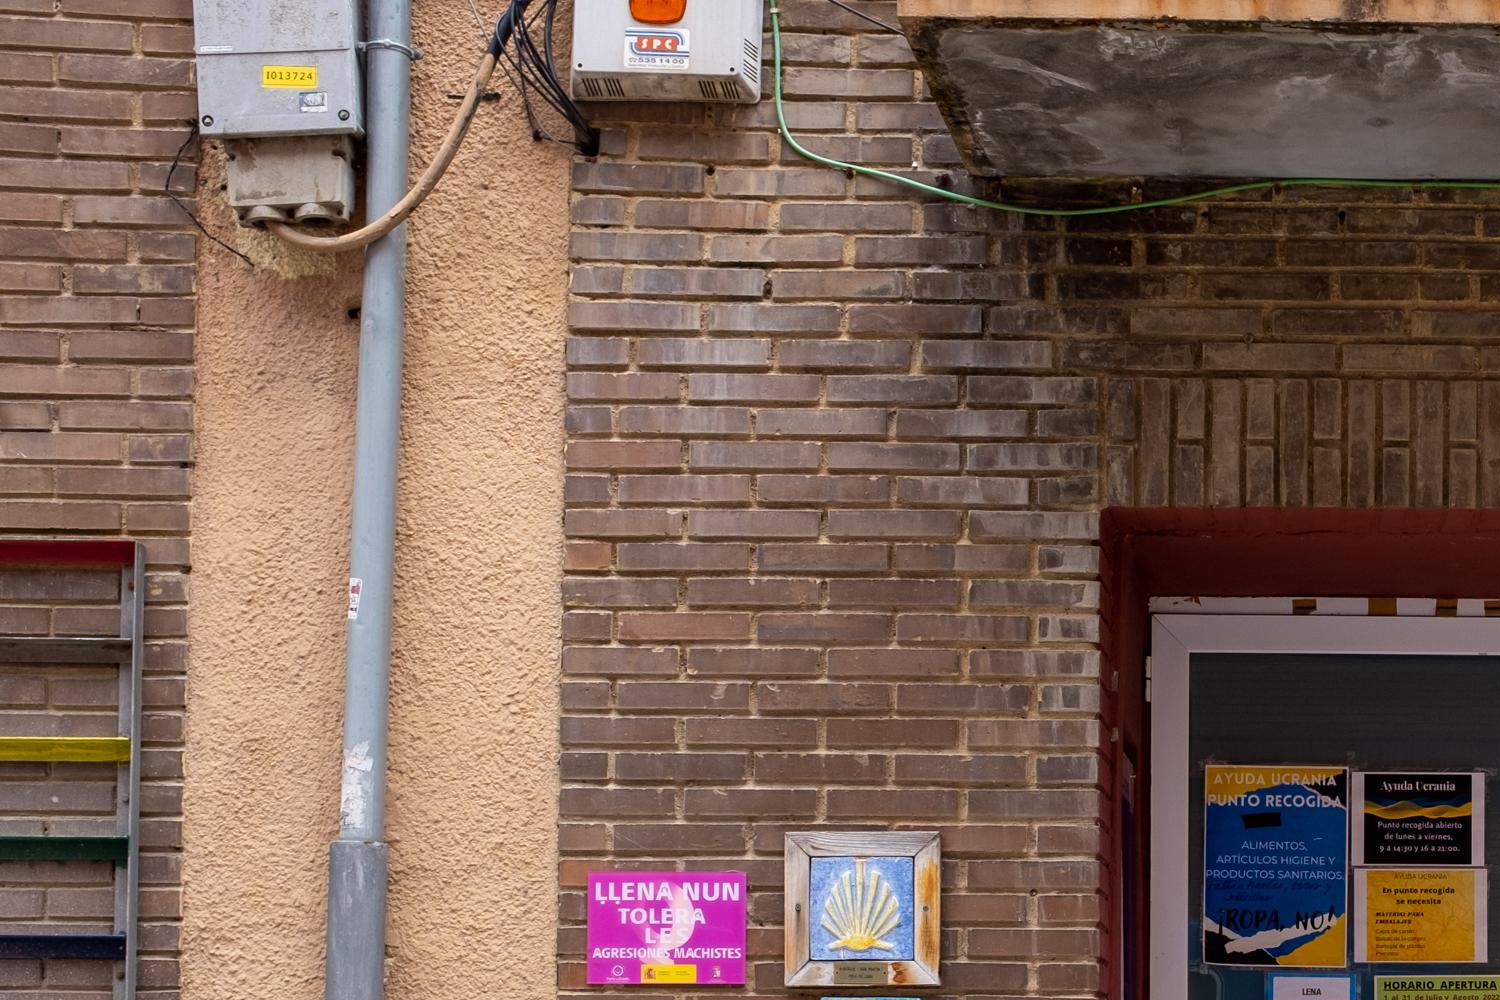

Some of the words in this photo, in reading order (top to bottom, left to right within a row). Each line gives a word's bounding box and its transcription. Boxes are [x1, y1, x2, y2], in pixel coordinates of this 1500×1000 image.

[641, 39, 672, 50] SPC
[1213, 772, 1266, 786] AYUDA
[1271, 772, 1337, 786] UCRANIA
[1379, 780, 1414, 792] Ayuda
[1416, 780, 1456, 791] Ucrania
[1206, 794, 1260, 808] PUNTO
[1265, 794, 1344, 808] RECOGIDA
[1378, 821, 1400, 829] Punto
[1402, 821, 1434, 830] recogida
[1436, 821, 1462, 830] abierto
[1384, 832, 1394, 840] de
[1396, 832, 1416, 840] lunes
[1241, 840, 1308, 852] ALIMENTOS,
[1280, 855, 1326, 865] HIGIENE
[1328, 856, 1336, 865] Y
[1206, 869, 1275, 880] PRODUCTOS
[682, 882, 740, 902] NUN
[1394, 888, 1418, 896] punto
[1420, 886, 1456, 896] recogida
[618, 908, 706, 924] TOLERA
[645, 927, 689, 944] LES
[592, 947, 671, 959] AGRESIONES
[674, 947, 742, 959] MACHISTES
[1384, 981, 1434, 990] HORARIO
[1440, 980, 1498, 990] APERTURA
[1302, 988, 1322, 996] LENA
